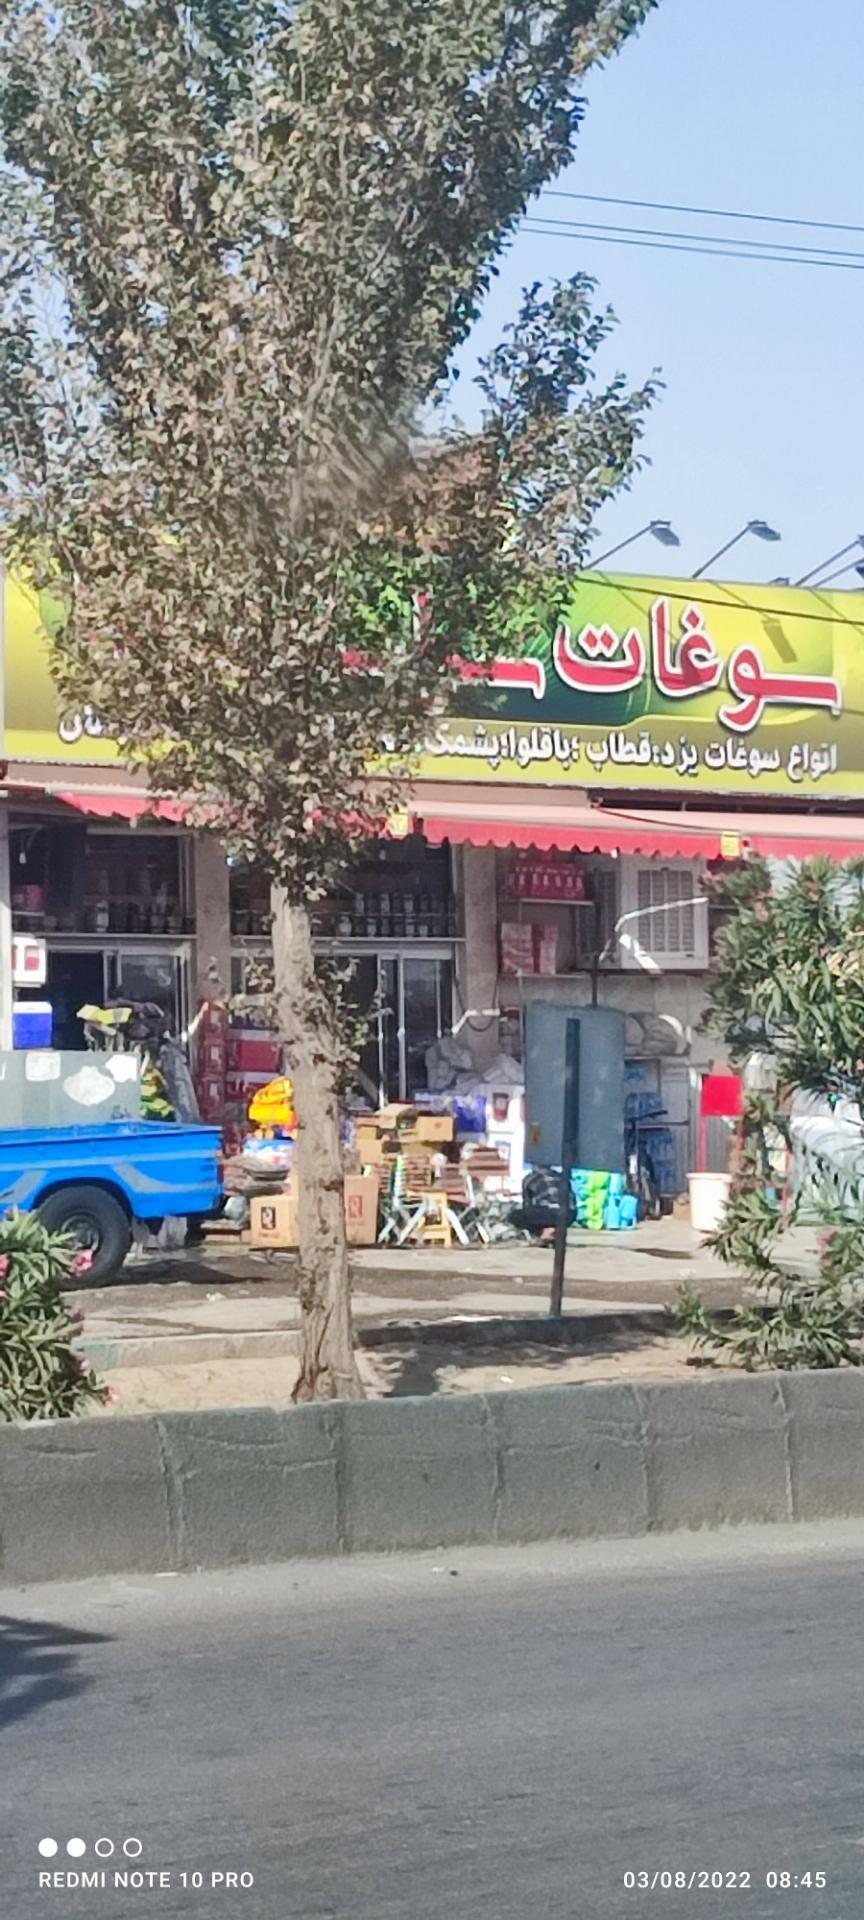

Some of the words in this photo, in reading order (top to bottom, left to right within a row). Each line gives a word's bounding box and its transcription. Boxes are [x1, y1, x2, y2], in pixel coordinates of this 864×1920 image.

[552, 596, 842, 733] سوغات
[705, 738, 780, 776] سوغات
[787, 743, 838, 781] انواع
